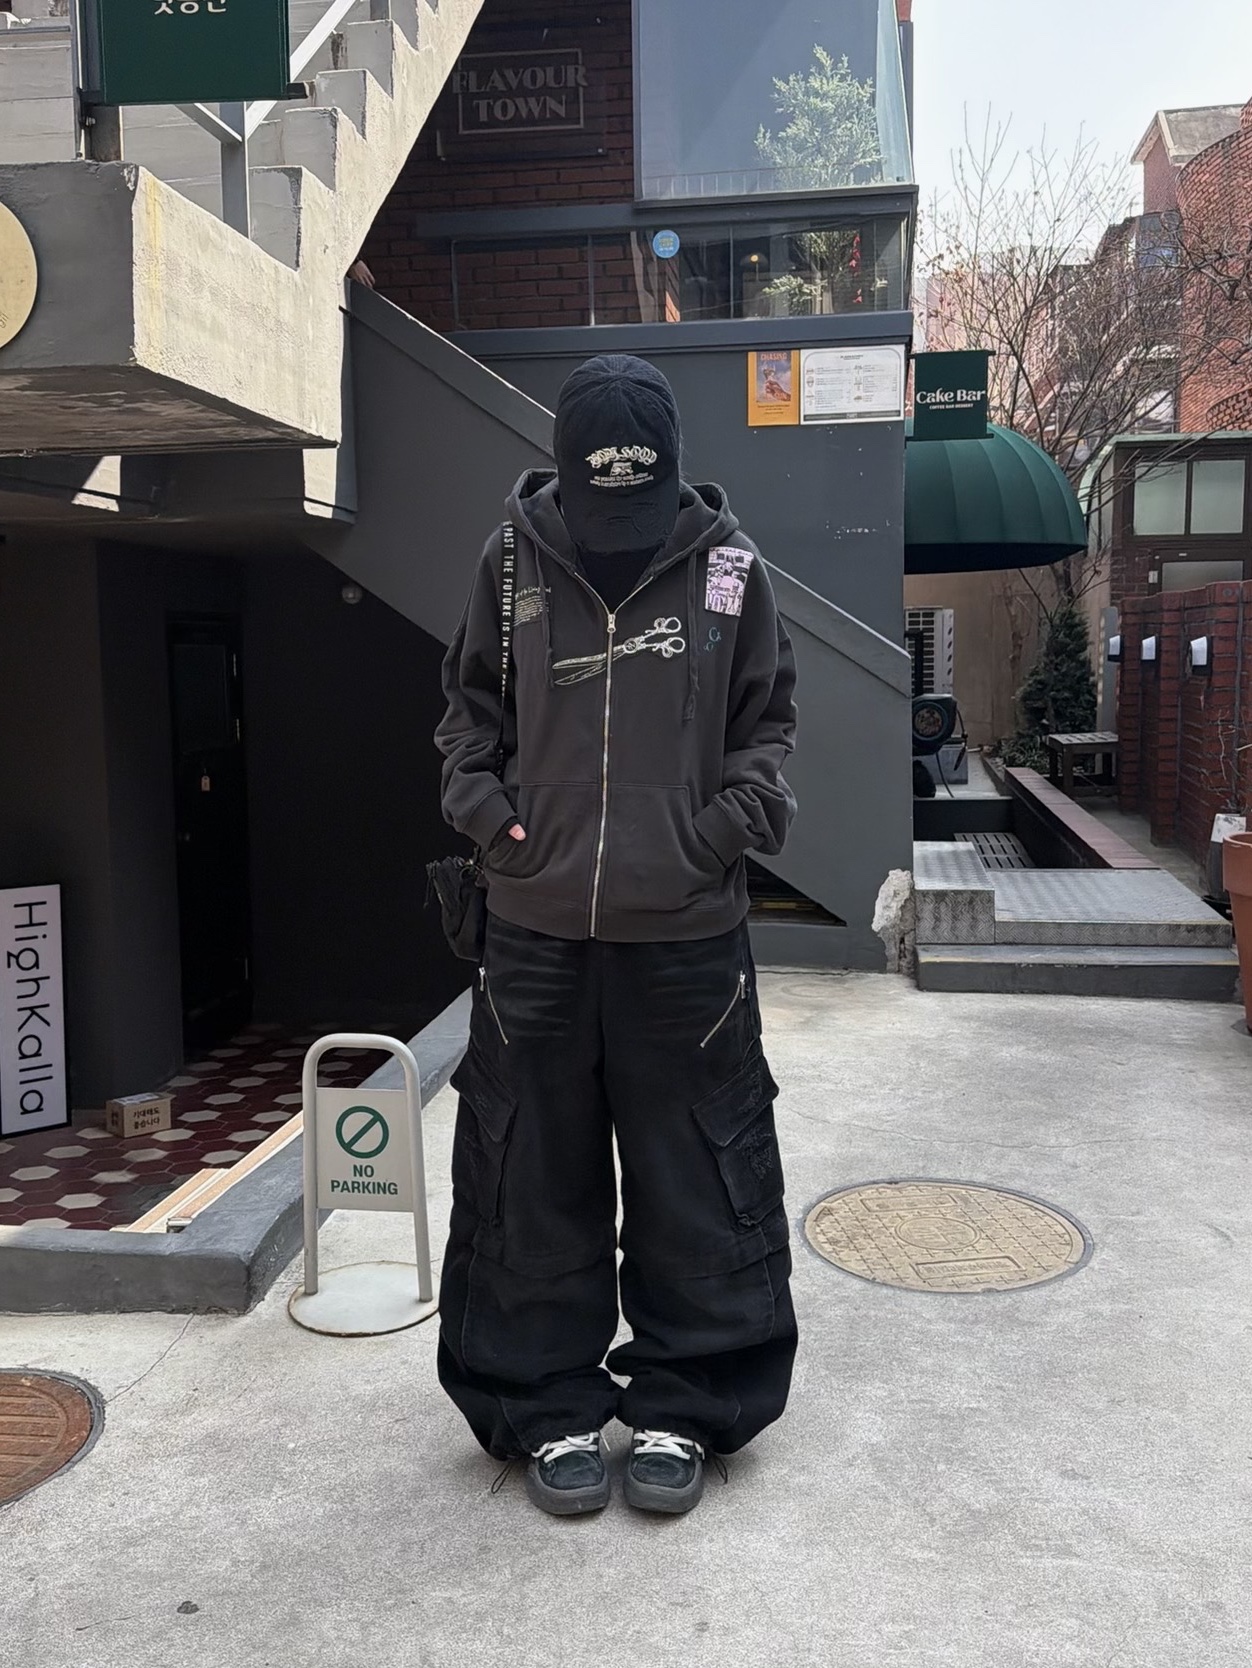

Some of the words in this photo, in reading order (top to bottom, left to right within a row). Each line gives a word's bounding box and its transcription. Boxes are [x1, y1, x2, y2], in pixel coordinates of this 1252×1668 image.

[452, 65, 588, 93] FLAVOUR
[473, 95, 566, 122] TOWN
[916, 387, 954, 405] Cake
[956, 389, 986, 402] Bar
[503, 527, 514, 549] PAST
[503, 555, 514, 573] THE
[502, 578, 513, 617] FUTURE
[502, 621, 511, 632] IS
[501, 636, 510, 648] IN
[7, 901, 53, 1115] HighKalla
[134, 1117, 160, 1130] 좋습니다
[353, 1164, 375, 1178] NO
[331, 1179, 398, 1195] PARKING
